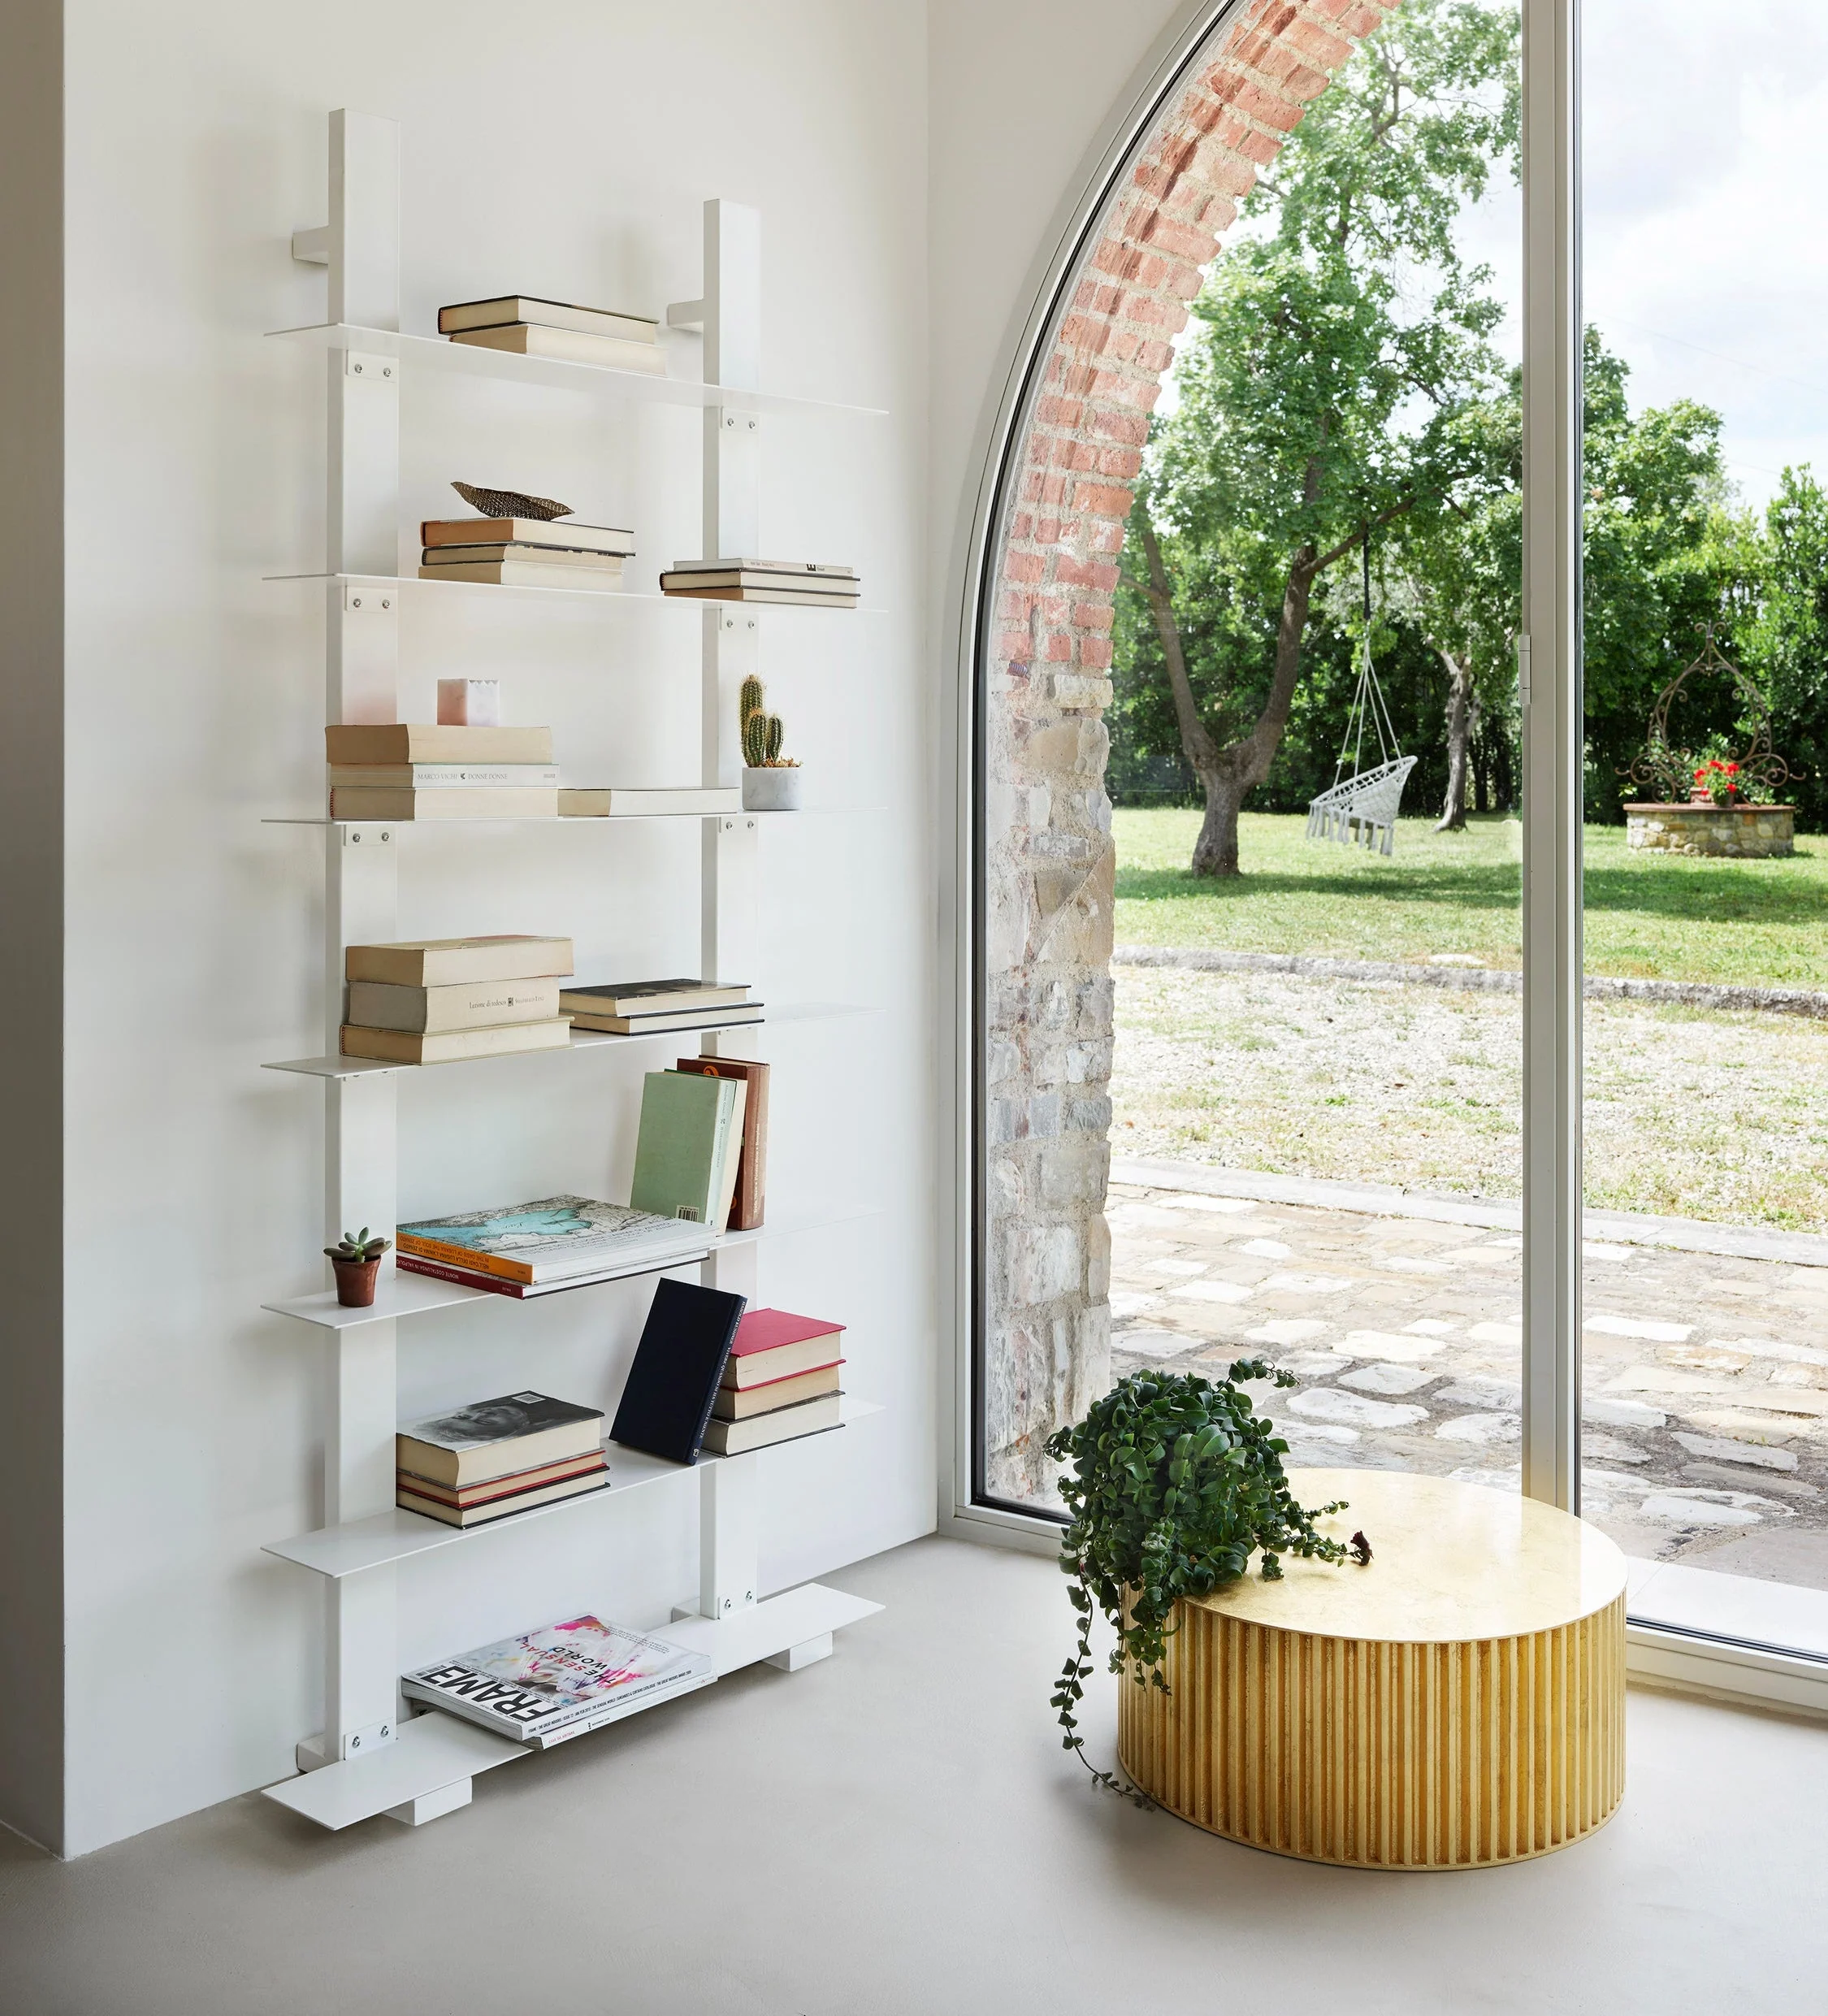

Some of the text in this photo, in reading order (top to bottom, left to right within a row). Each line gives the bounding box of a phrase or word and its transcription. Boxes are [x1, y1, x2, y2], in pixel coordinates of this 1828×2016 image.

[455, 1255, 469, 1264] DELLA
[444, 1271, 458, 1279] MONTE
[737, 1301, 747, 1321] HAROLD
[723, 1346, 731, 1364] VIVERE
[717, 1364, 726, 1385] QUANDO
[706, 1400, 715, 1416] TUTTO
[520, 1641, 587, 1671] SENSUAL
[552, 1646, 609, 1670] WORLD
[584, 1669, 617, 1684] THE
